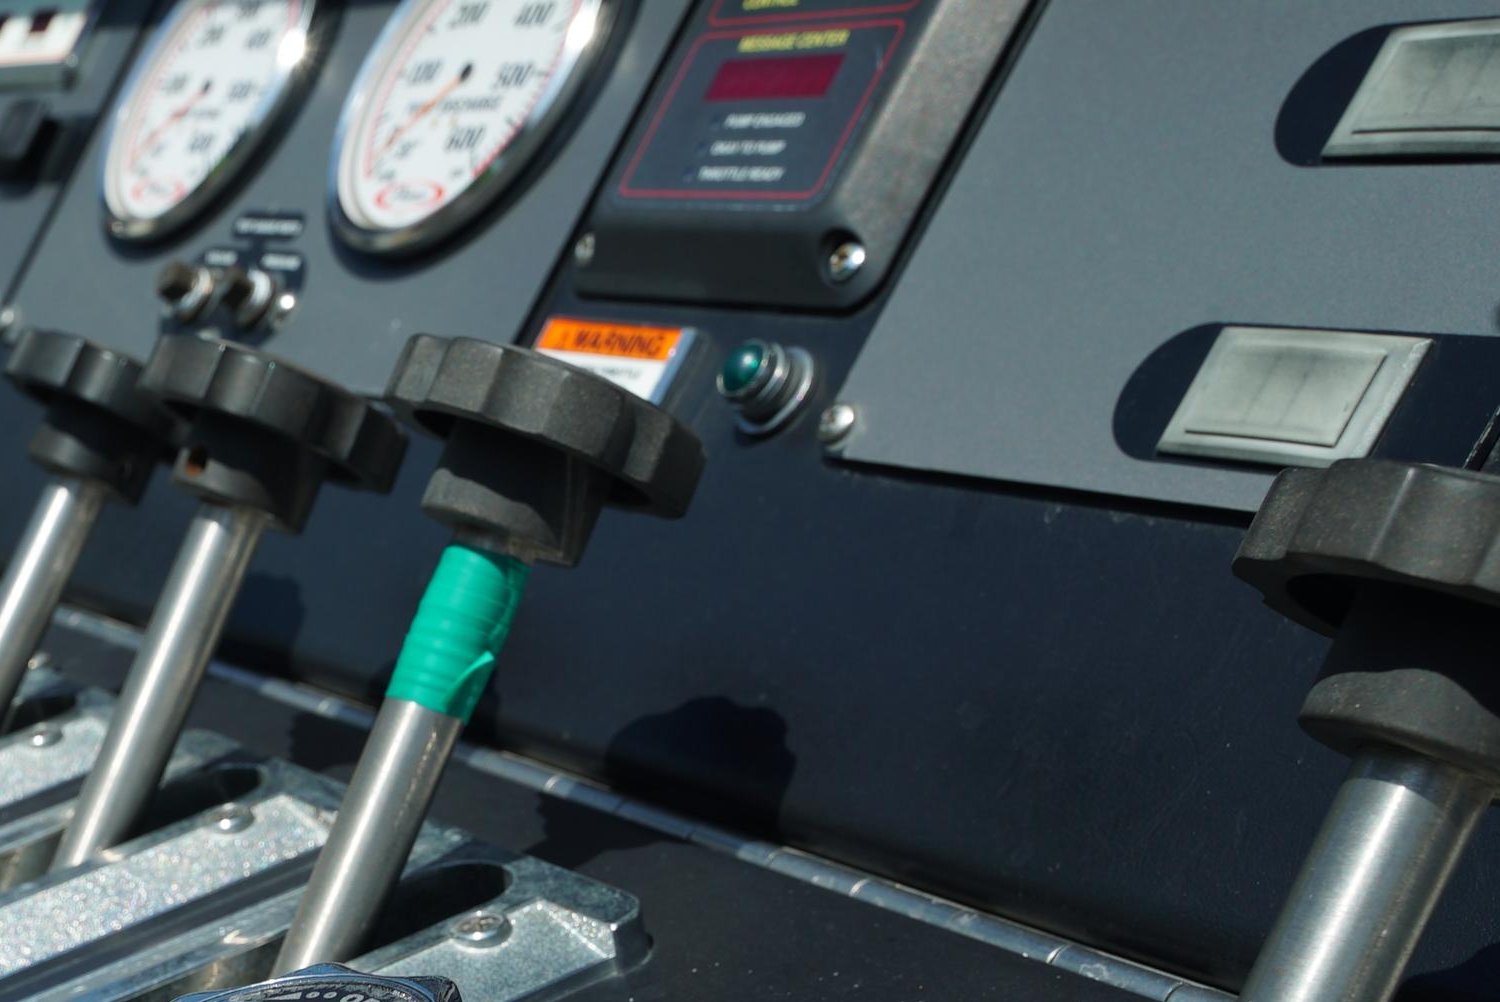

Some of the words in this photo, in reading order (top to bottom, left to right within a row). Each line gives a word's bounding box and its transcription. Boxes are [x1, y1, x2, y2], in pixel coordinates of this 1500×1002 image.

[737, 32, 799, 53] MESSAGE
[795, 29, 851, 49] CENTER
[573, 329, 664, 355] WARNING
